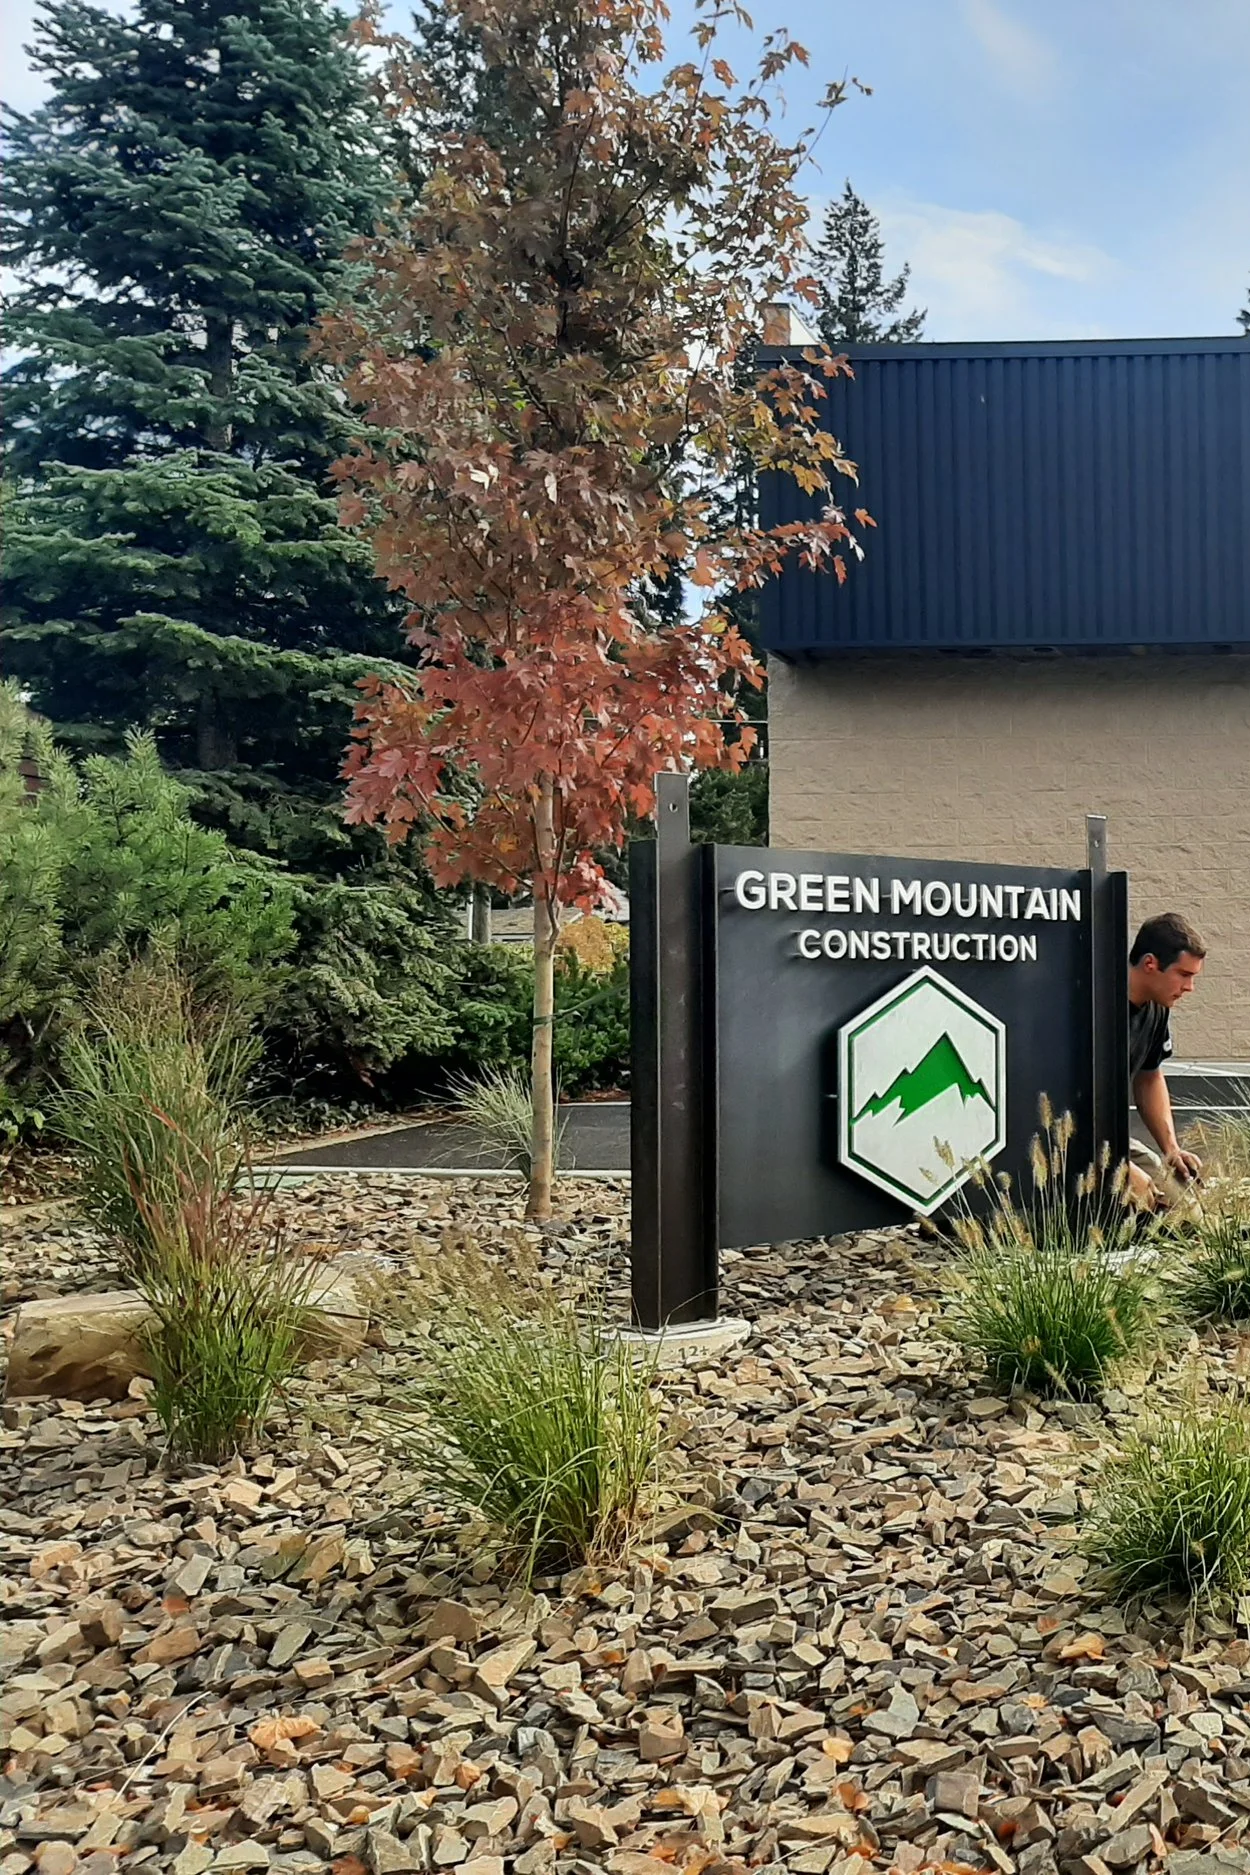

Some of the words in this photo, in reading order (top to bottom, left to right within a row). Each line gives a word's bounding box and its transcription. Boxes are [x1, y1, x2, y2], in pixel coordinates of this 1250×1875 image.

[735, 870, 880, 914] GREEN
[890, 879, 1081, 921] MOUNTAIN
[798, 929, 1037, 962] CONSTRUCTION
